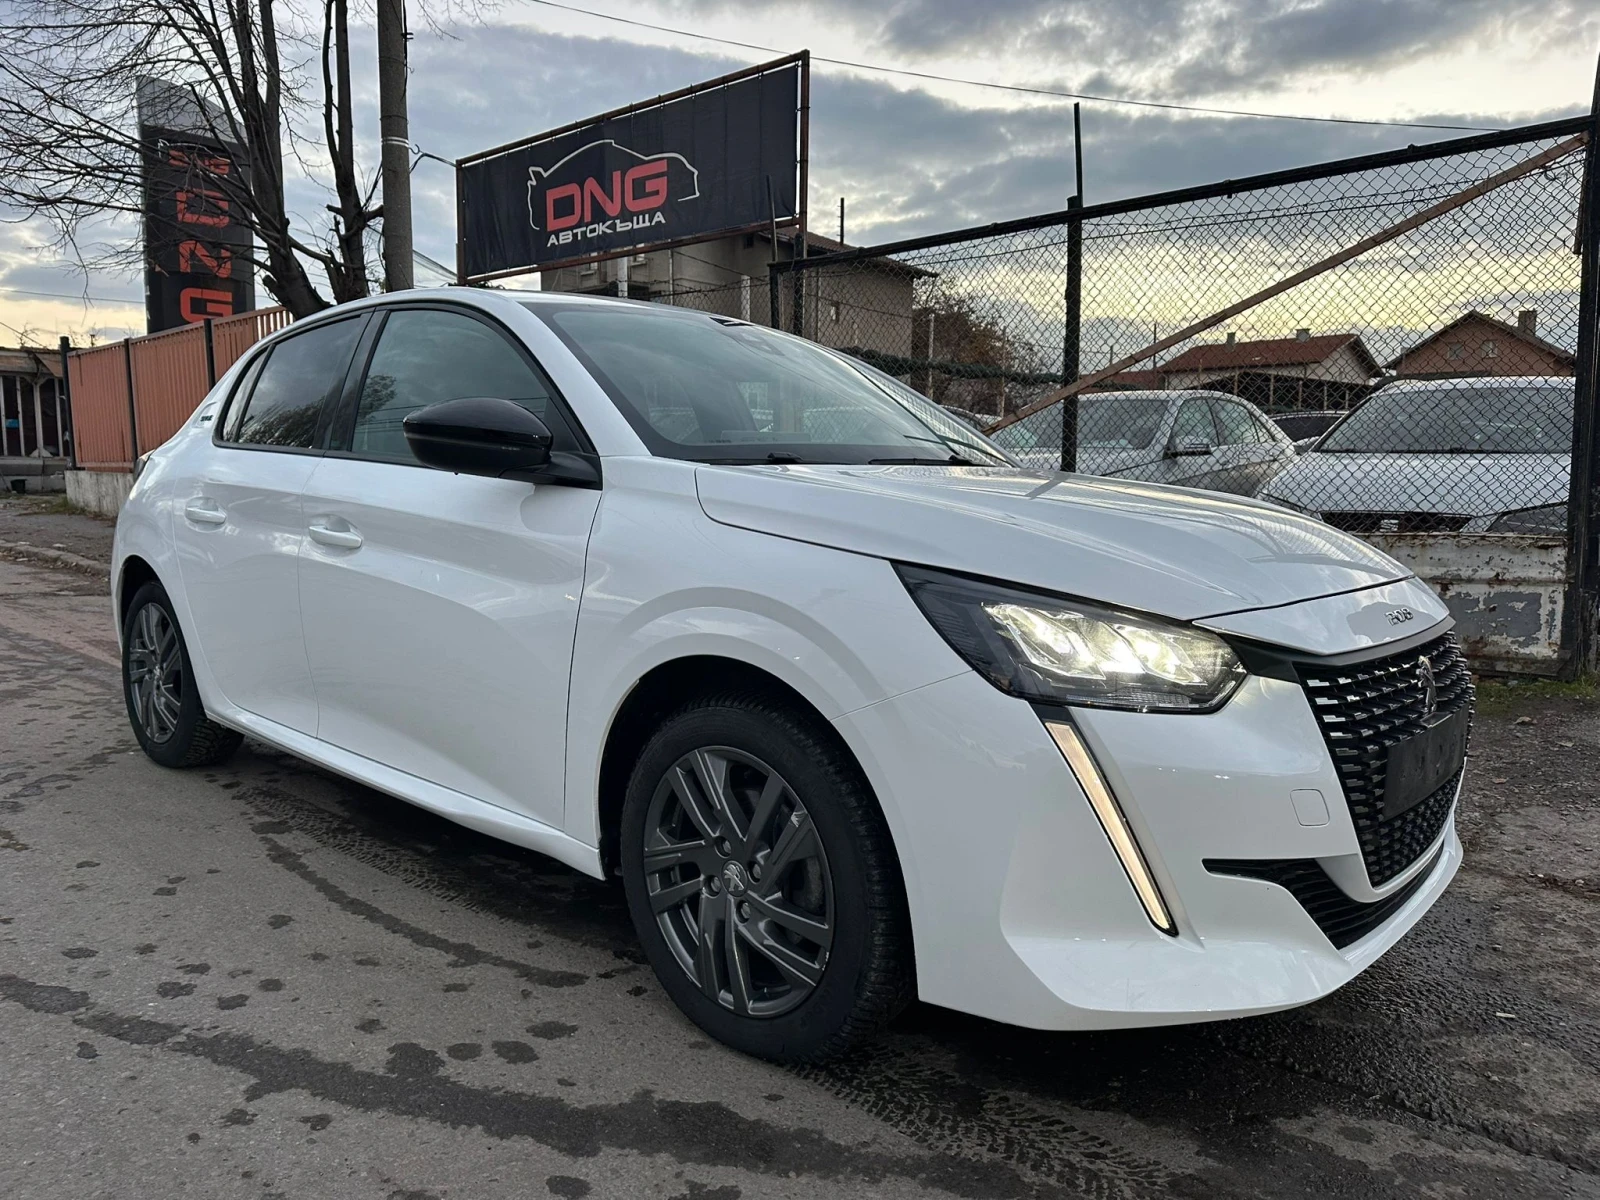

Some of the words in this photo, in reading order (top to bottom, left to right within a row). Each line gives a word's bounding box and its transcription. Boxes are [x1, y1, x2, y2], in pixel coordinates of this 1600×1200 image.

[545, 159, 668, 232] DNG
[176, 187, 233, 323] DNG
[1384, 608, 1414, 626] 208
